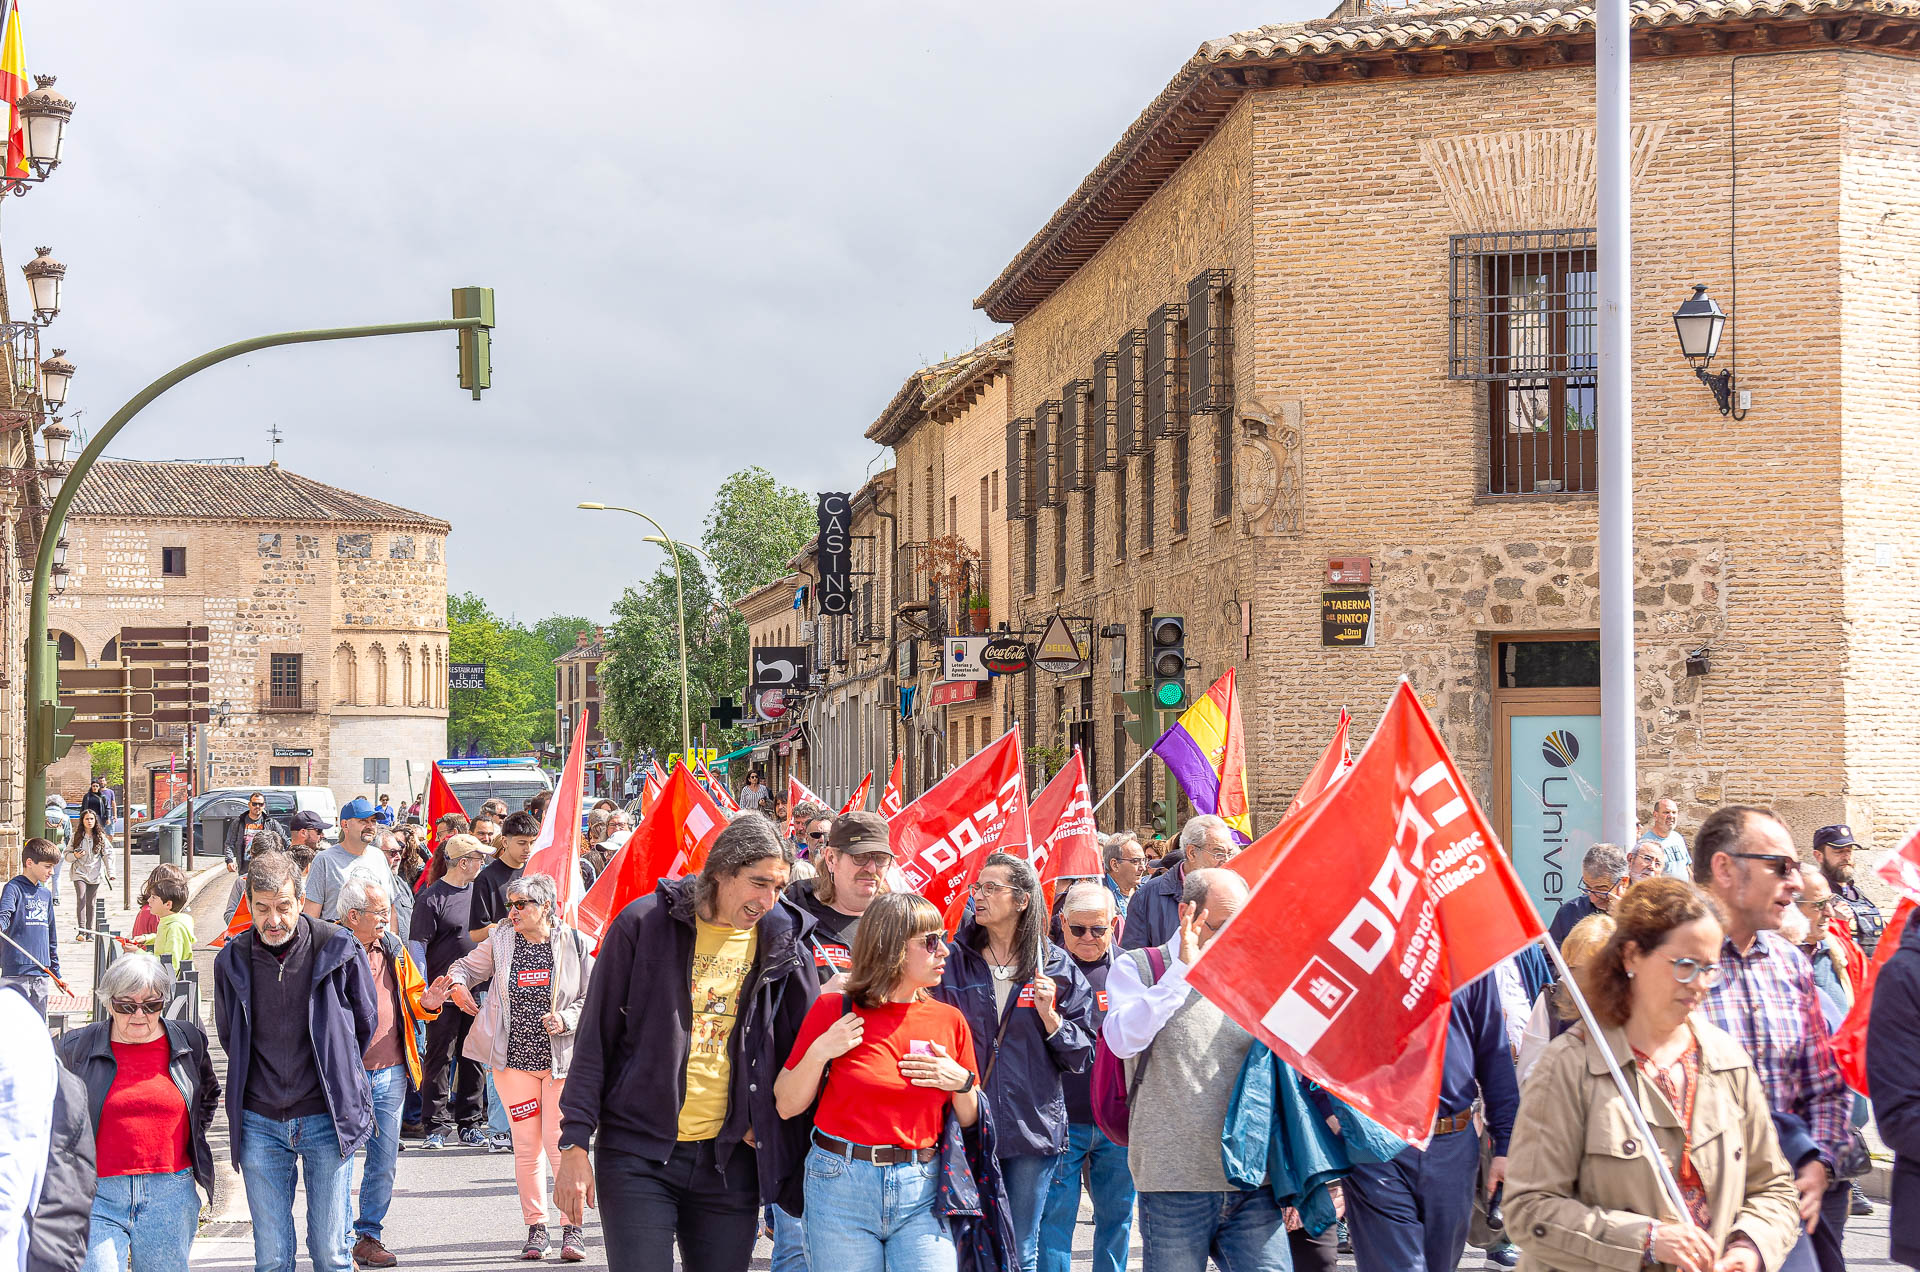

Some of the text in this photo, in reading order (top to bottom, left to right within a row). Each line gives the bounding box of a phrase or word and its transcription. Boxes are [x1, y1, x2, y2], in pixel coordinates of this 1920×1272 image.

[824, 496, 846, 611] CASINO
[1330, 600, 1371, 610] TABERNA
[1336, 613, 1369, 624] PINTOR
[1045, 643, 1072, 653] DELTA
[448, 679, 484, 689] ABSIDE
[1542, 776, 1569, 907] Univer
[519, 971, 549, 981] CCOO
[510, 1100, 538, 1116] CCOO
